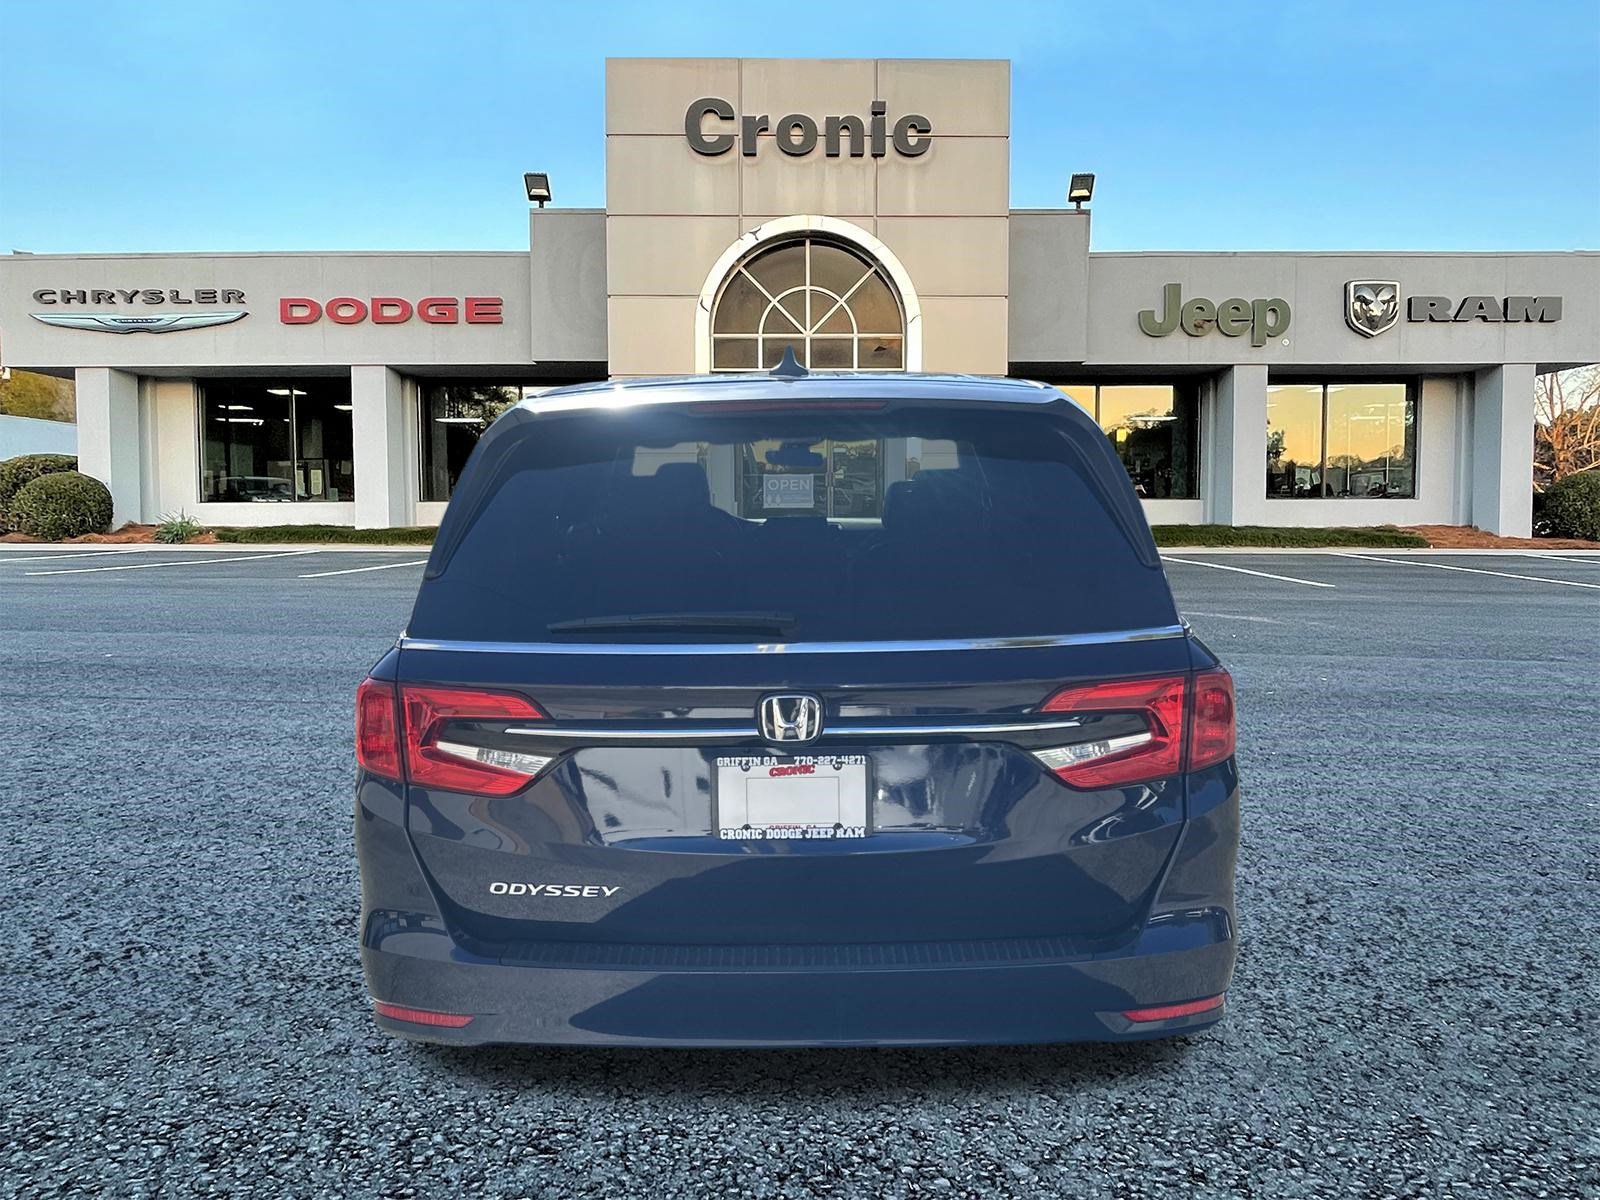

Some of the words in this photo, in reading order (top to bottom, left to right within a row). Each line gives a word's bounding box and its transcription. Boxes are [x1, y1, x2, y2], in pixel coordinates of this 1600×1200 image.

[684, 97, 932, 157] Cronic
[32, 287, 247, 305] CHRYSLER
[279, 297, 504, 324] DODGE
[1138, 283, 1291, 347] Jeep
[1407, 296, 1563, 323] RAM
[767, 479, 810, 491] OPEN
[717, 757, 762, 767] GRIFFIN
[763, 757, 778, 766] GA
[794, 755, 867, 765] 770-227-4271
[720, 828, 763, 840] CRONIC
[765, 828, 803, 840] DODGE
[804, 828, 834, 840] JEEP
[835, 827, 866, 839] RAM
[489, 882, 620, 898] ODYSSEY
